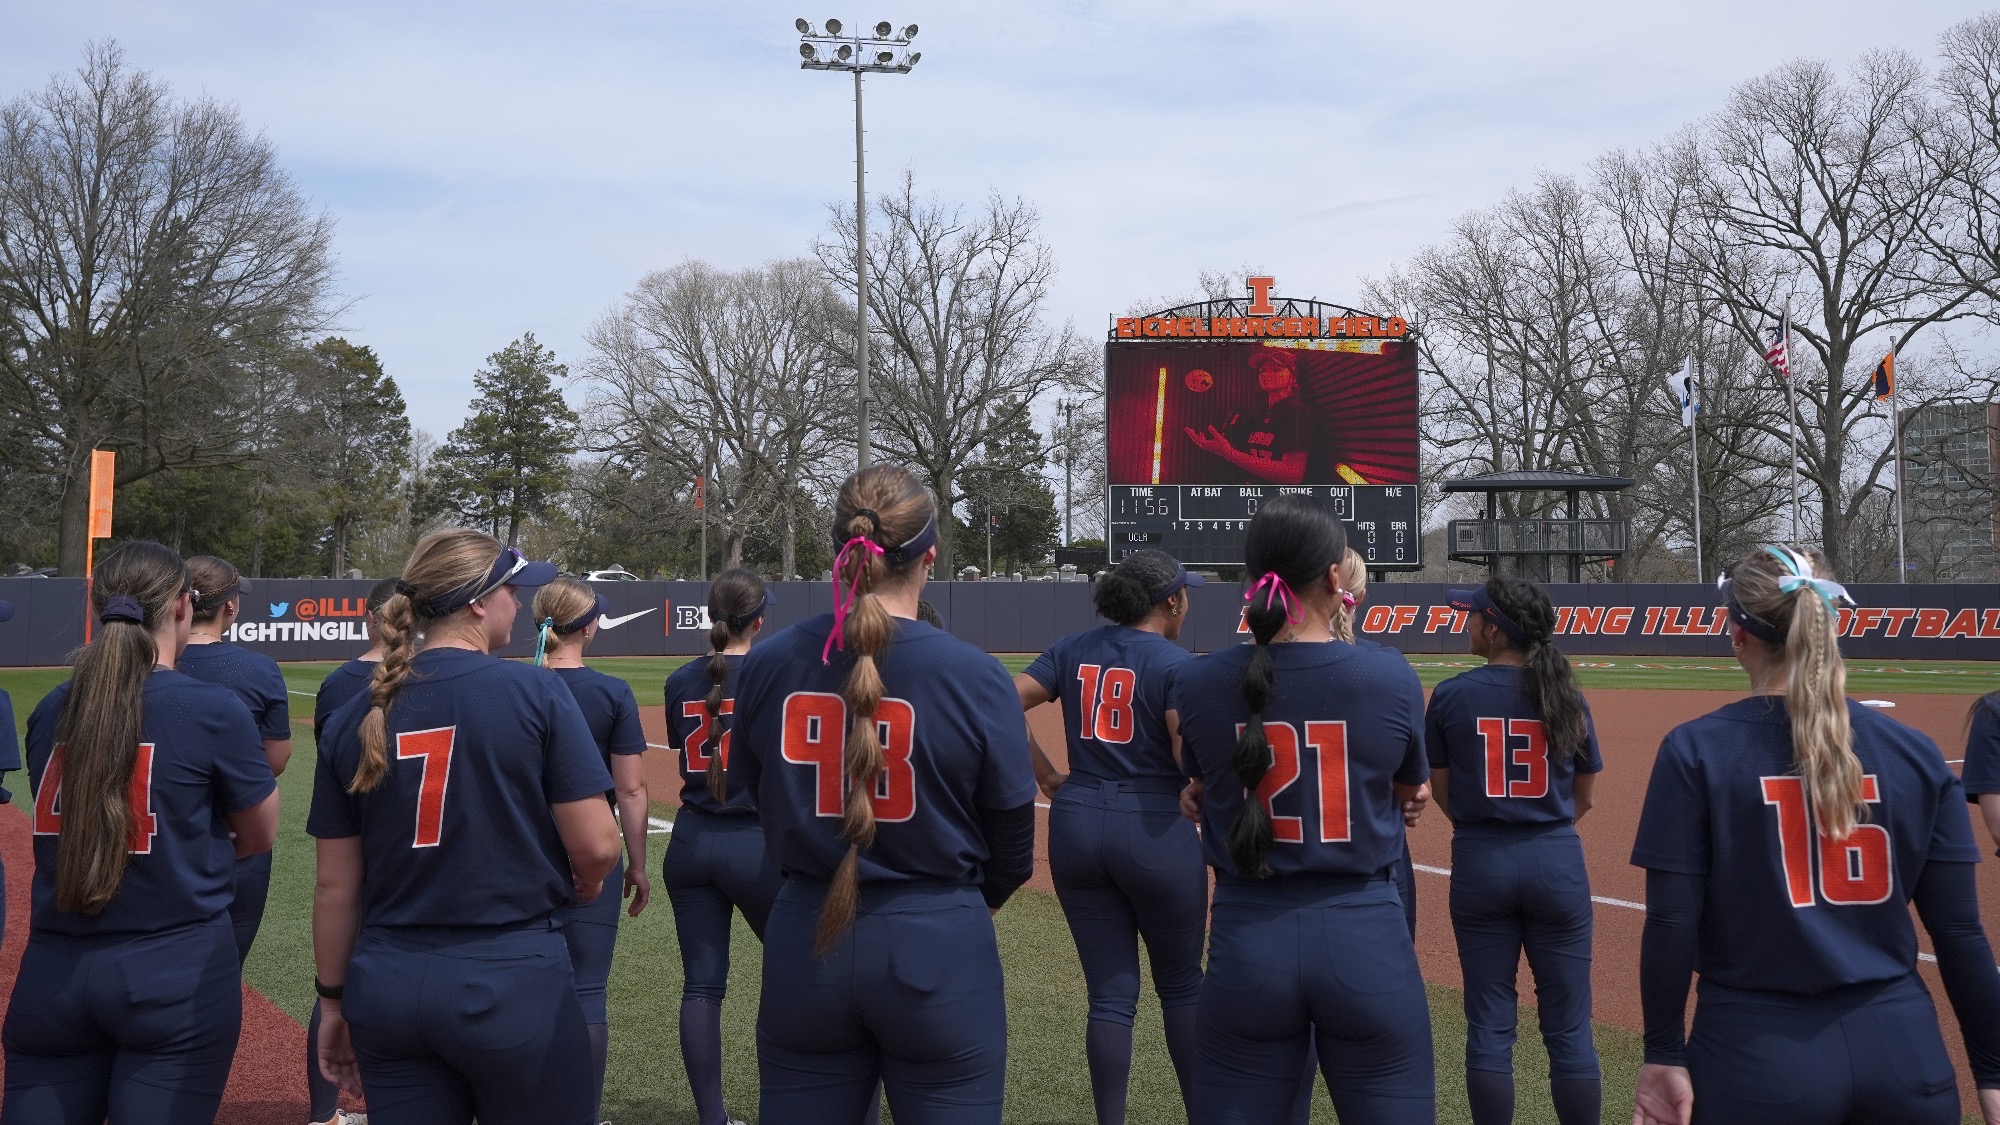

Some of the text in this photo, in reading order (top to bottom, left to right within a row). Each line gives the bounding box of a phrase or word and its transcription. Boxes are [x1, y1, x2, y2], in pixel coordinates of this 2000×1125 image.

[1117, 317, 1407, 338] EICHELBERGER FIELD
[1130, 487, 1154, 497] TIME
[1190, 487, 1222, 497] AT BAT
[1239, 487, 1263, 497] BALL
[1279, 487, 1313, 497] STRIKE
[1330, 487, 1349, 497] OUT
[1385, 487, 1402, 497] H/E
[1334, 498, 1345, 515] 0
[1171, 521, 1244, 530] 1 2 3 4 5 6
[1357, 521, 1376, 530] HITS
[1391, 521, 1407, 530] ERR
[1128, 532, 1148, 542] UCLA
[1367, 547, 1404, 560] 0 0
[295, 597, 367, 621] @ILLI
[1362, 605, 1419, 634] OF
[1423, 605, 1636, 635] FIING
[1640, 606, 1731, 635] ILLI
[1077, 663, 1136, 745] 18
[781, 691, 917, 823] 98
[1476, 716, 1549, 799] 13
[396, 725, 457, 849] 7
[1234, 720, 1352, 844] 21
[1759, 774, 1894, 909] 16
